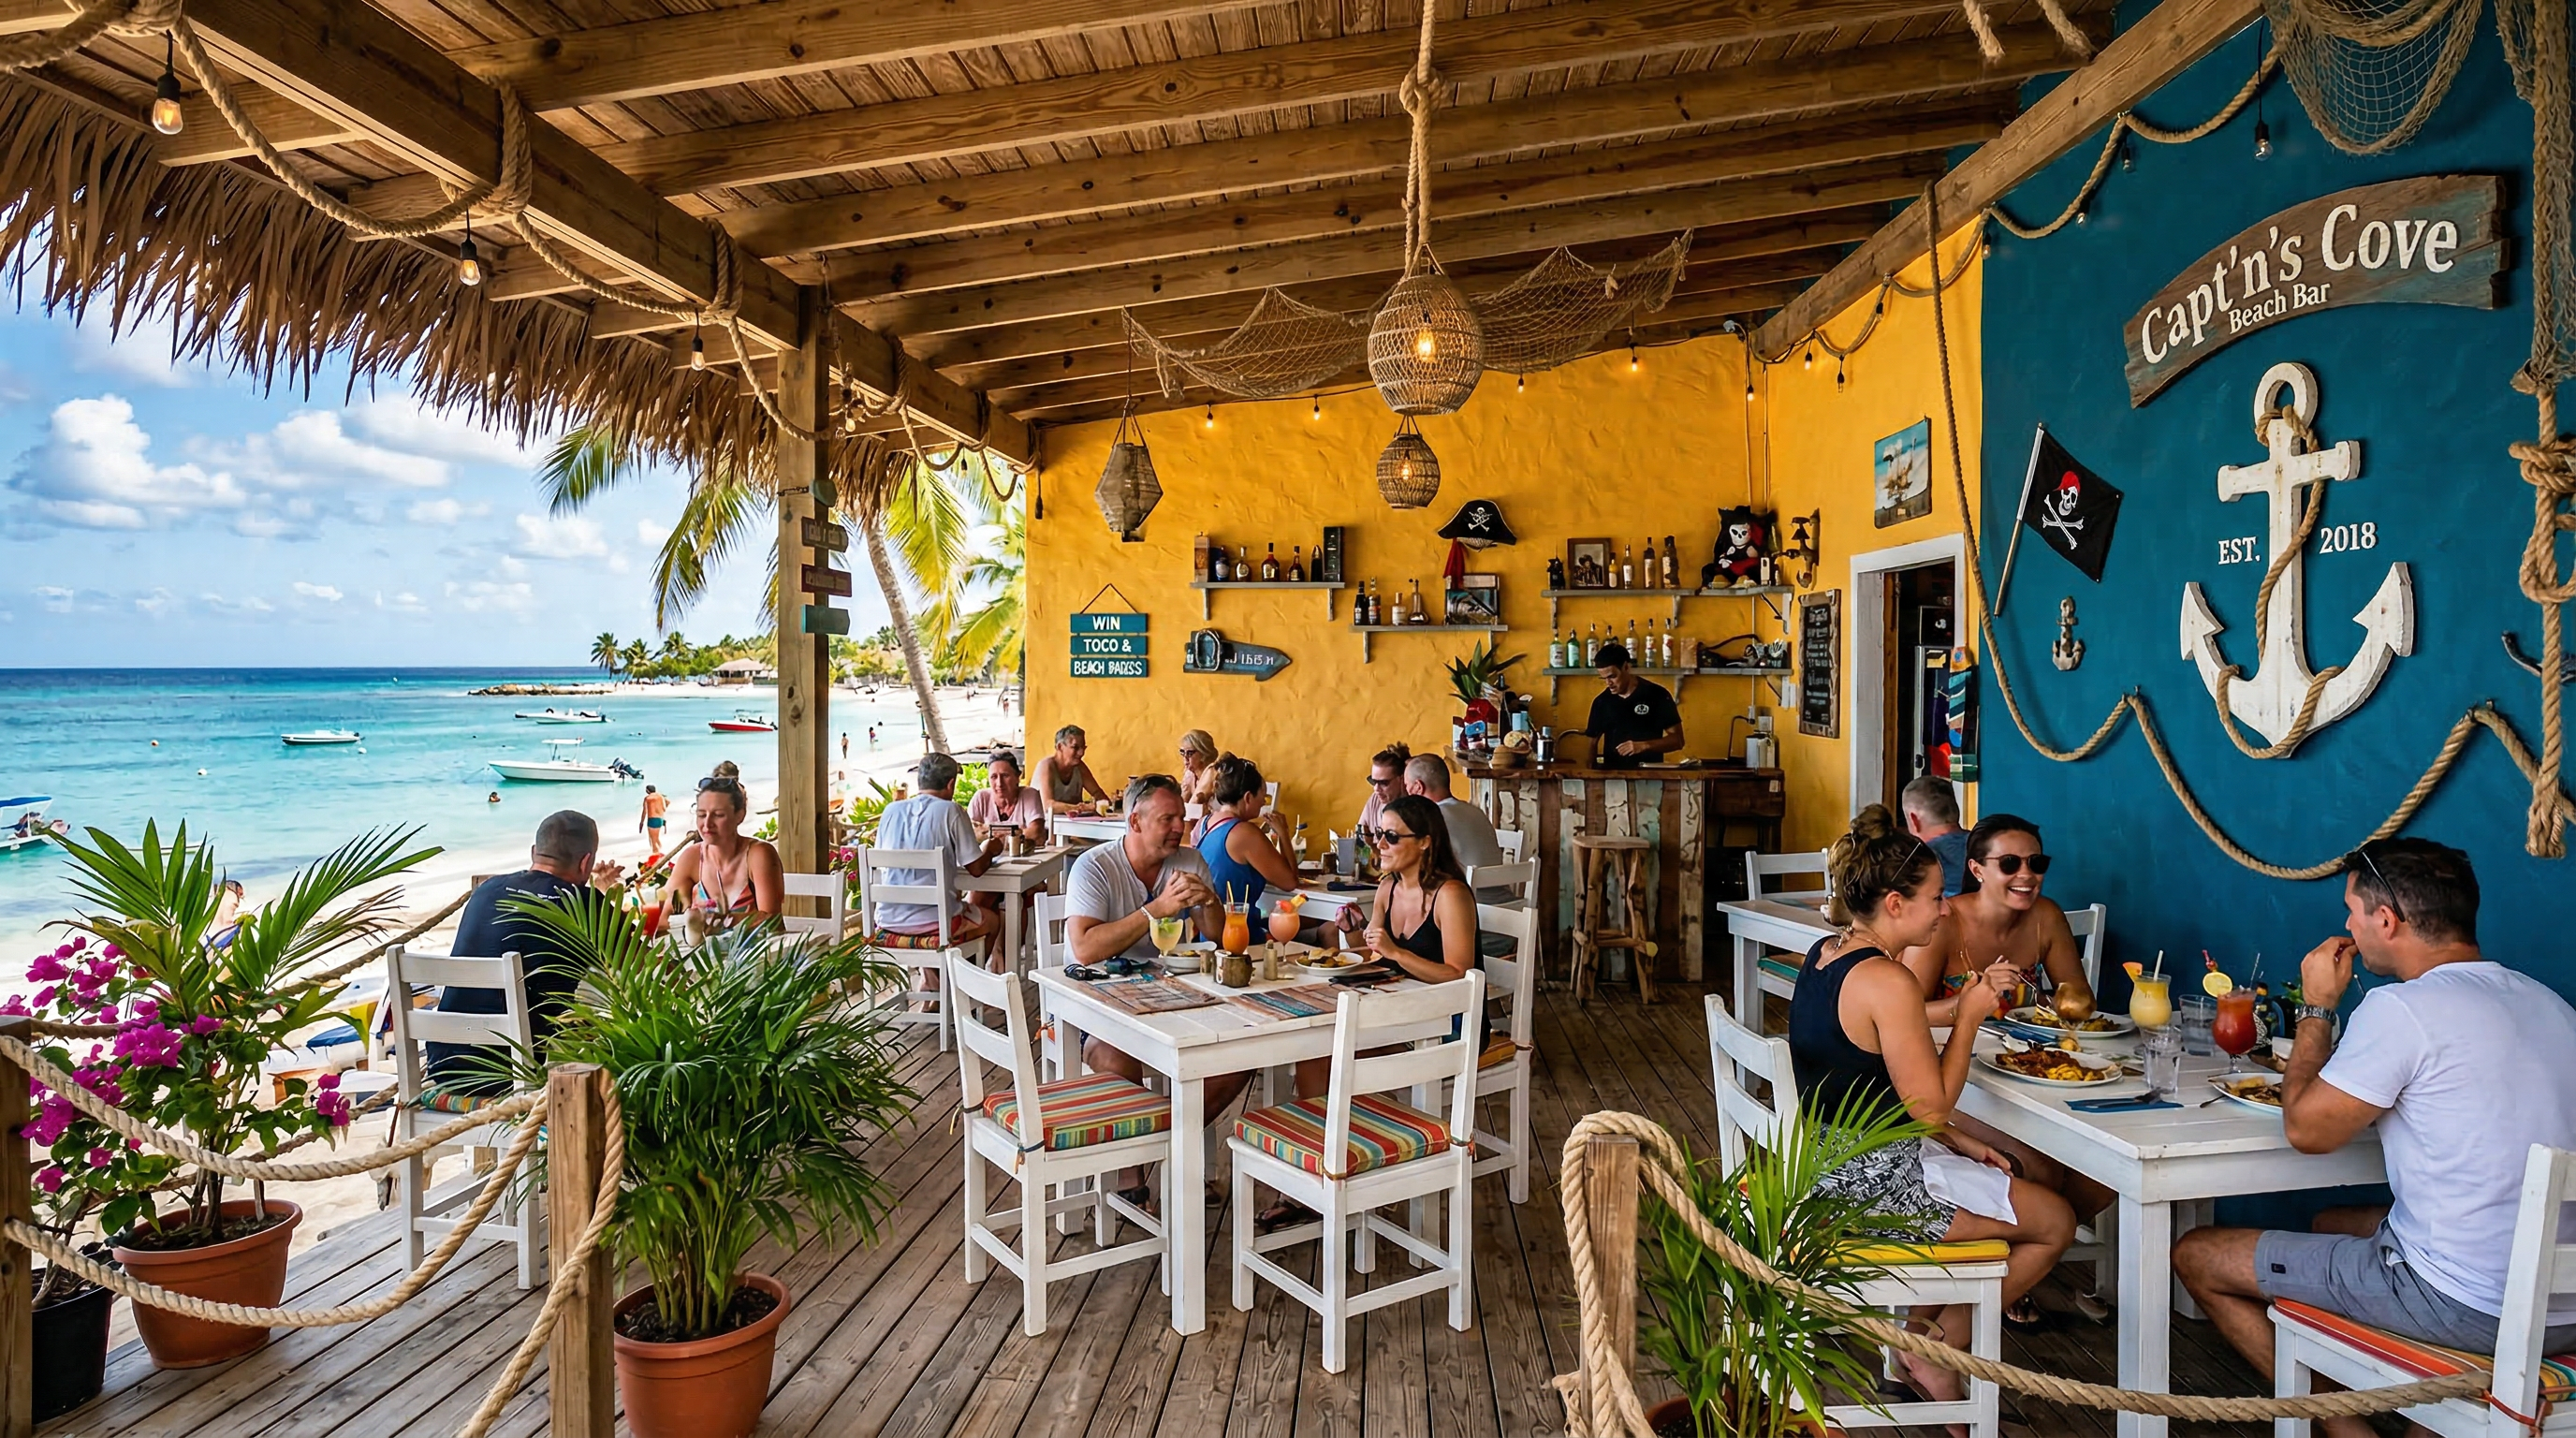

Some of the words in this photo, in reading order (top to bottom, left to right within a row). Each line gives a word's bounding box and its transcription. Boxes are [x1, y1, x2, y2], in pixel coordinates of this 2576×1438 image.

[2142, 227, 2302, 364] Capt'n's
[2321, 204, 2458, 273] Cove
[2229, 289, 2287, 334] Beach
[2292, 282, 2331, 309] Bar
[2218, 536, 2261, 565] EST.
[2319, 521, 2378, 554] 2018
[1092, 616, 1120, 631] WIN
[1083, 638, 1119, 653] TOCO
[1121, 638, 1132, 653] &
[1074, 660, 1105, 675] BEACH
